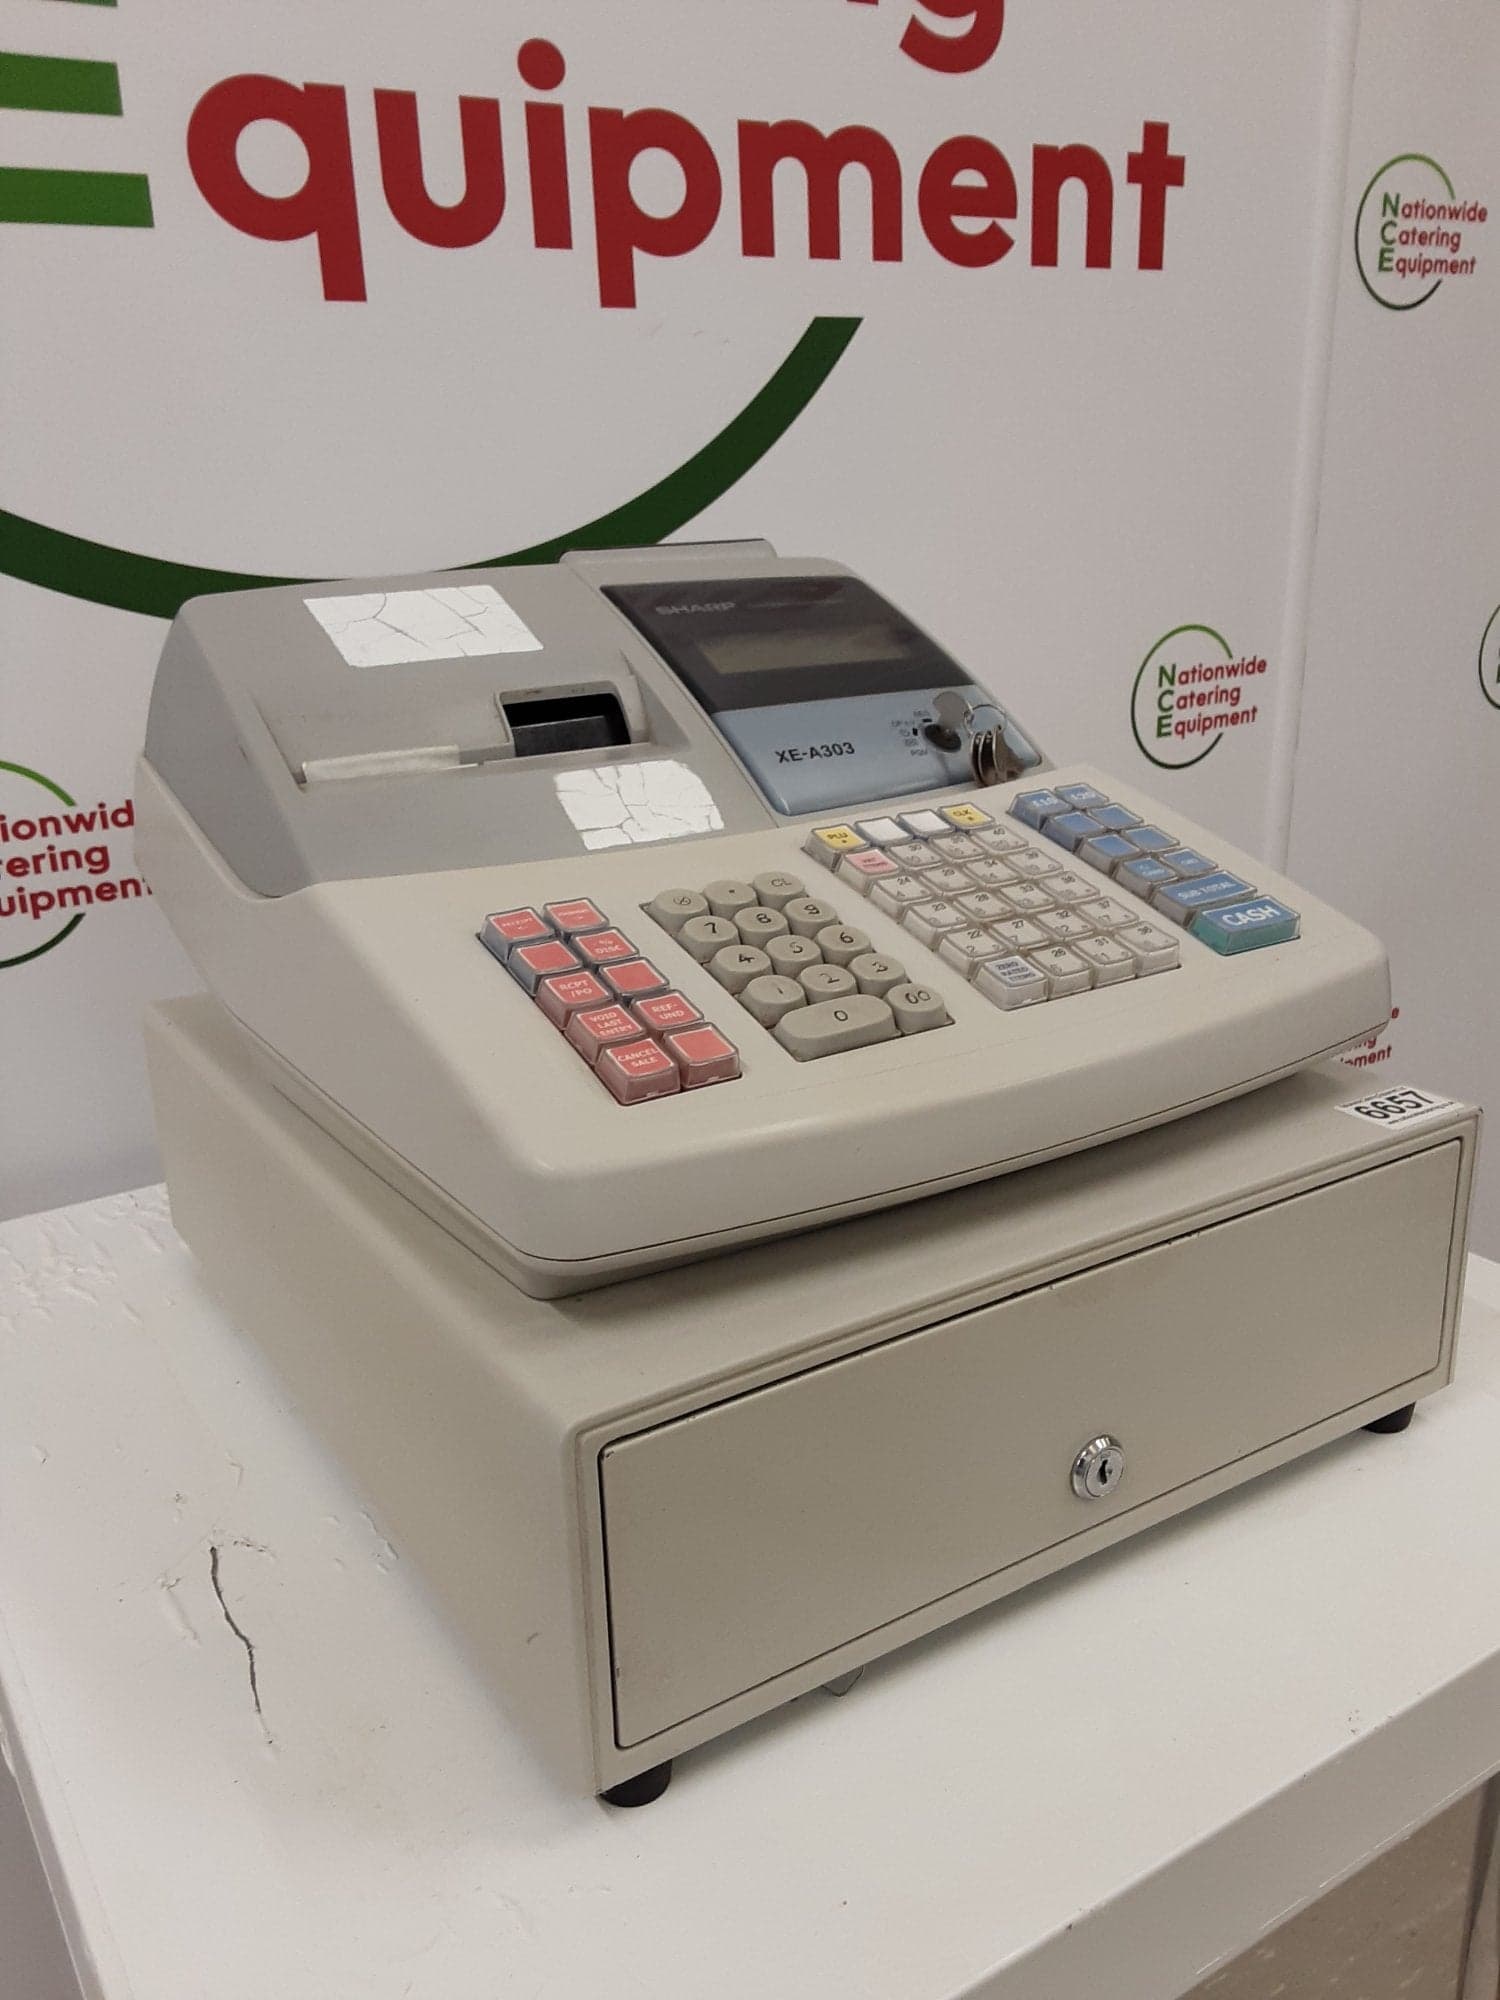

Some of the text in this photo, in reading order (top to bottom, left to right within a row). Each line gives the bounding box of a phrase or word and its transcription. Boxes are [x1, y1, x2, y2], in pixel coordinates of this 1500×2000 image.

[1382, 191, 1488, 223] Nationwide
[1380, 220, 1462, 253] Catering
[1378, 247, 1476, 279] Equipment
[655, 602, 737, 616] SHARP
[1158, 654, 1268, 689] Nationwide
[1157, 684, 1242, 714] Catering
[1156, 704, 1258, 740] Equipment
[775, 742, 856, 764] XE-A303
[0, 844, 110, 877] ering
[771, 878, 791, 888] CL
[897, 876, 912, 885] 24
[803, 903, 821, 916] 9
[932, 903, 948, 912] 23
[756, 912, 773, 925] 8
[1221, 904, 1281, 927] CASH
[703, 922, 718, 935] 7
[1012, 919, 1024, 929] 27
[840, 931, 855, 944] 6
[967, 929, 983, 940] 22
[789, 941, 804, 955] 5
[738, 953, 756, 965] 4
[872, 961, 889, 974] 3
[819, 972, 841, 985] 2
[559, 979, 588, 992] RCPT
[776, 986, 785, 995] 1
[905, 989, 931, 1006] 00
[652, 1002, 678, 1012] REF-
[589, 1011, 617, 1023] VOID
[660, 1009, 685, 1020] UND
[833, 1009, 849, 1022] 0
[596, 1018, 622, 1029] LAST
[600, 1024, 634, 1036] ENTRY
[617, 1047, 659, 1062] CANCEL
[631, 1057, 658, 1068] SALE
[1354, 1090, 1434, 1119] 6657
